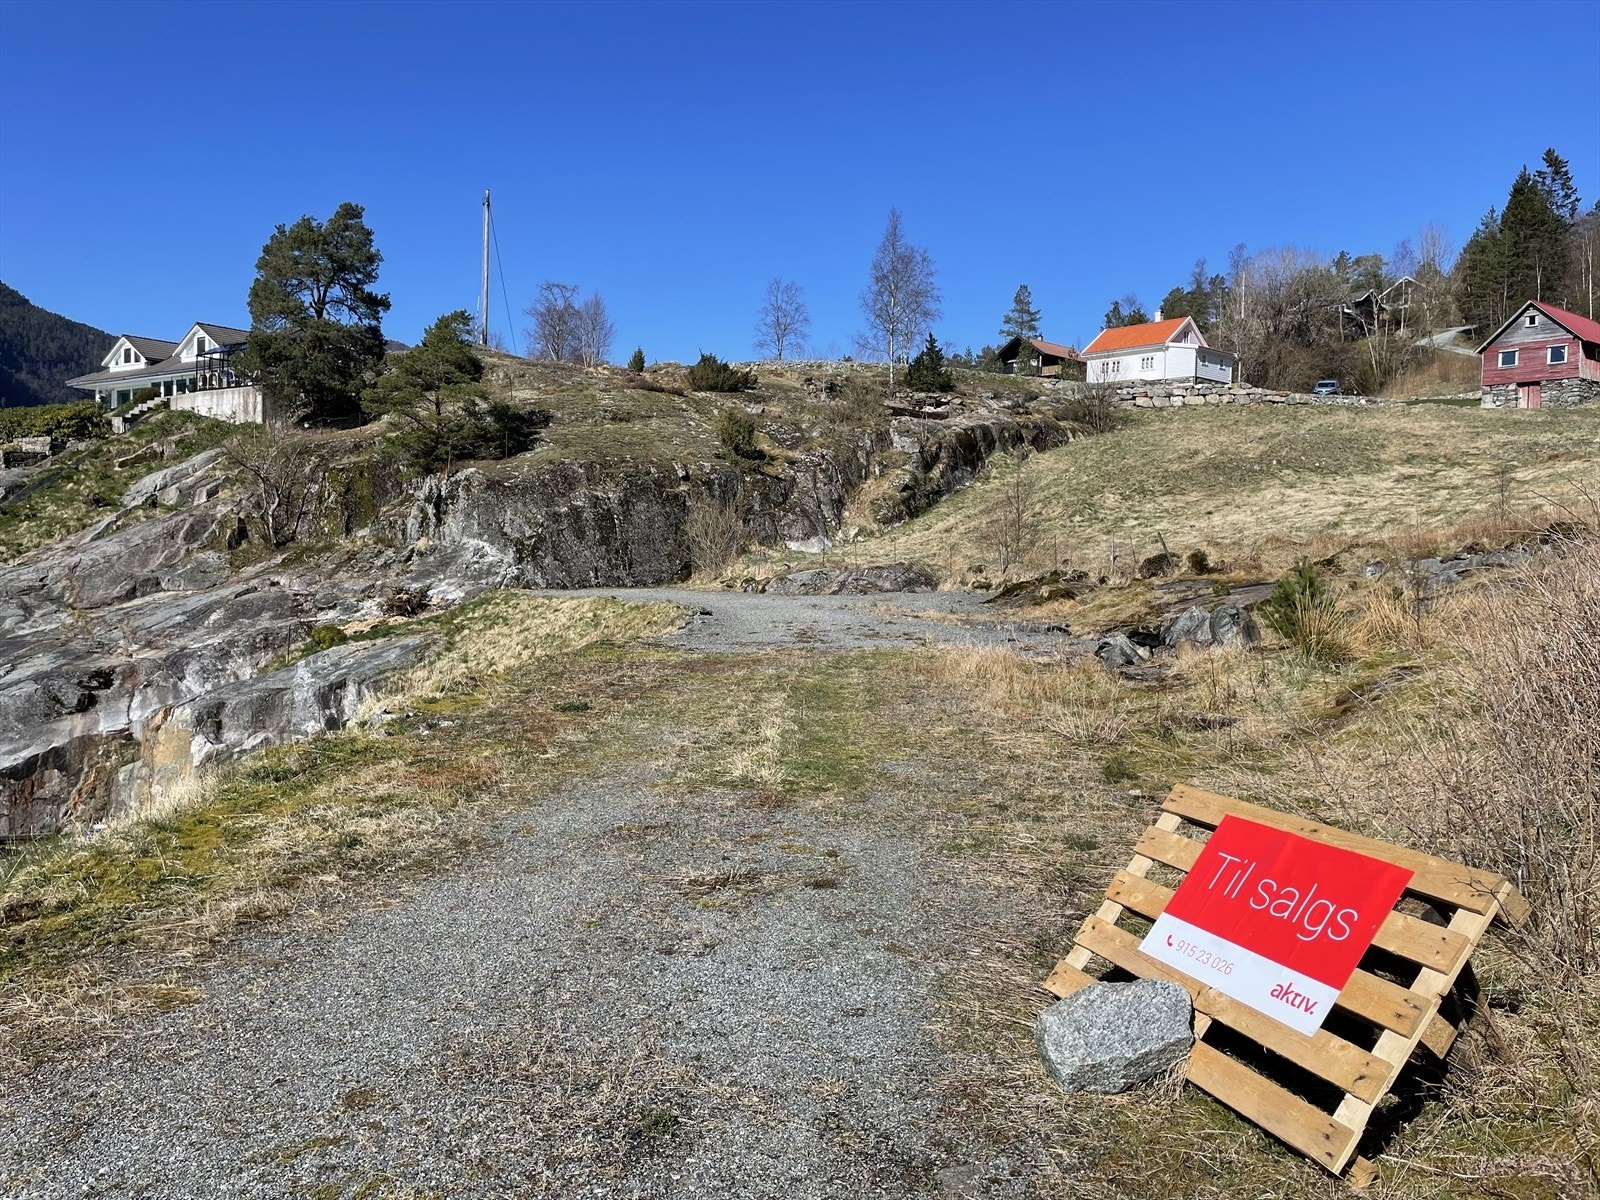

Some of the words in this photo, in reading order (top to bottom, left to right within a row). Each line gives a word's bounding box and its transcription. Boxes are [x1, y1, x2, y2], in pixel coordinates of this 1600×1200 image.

[1208, 851, 1256, 899] Til
[1249, 878, 1358, 941] salgs
[1175, 939, 1197, 958] 915
[1195, 949, 1212, 965] 23
[1210, 956, 1234, 975] 026
